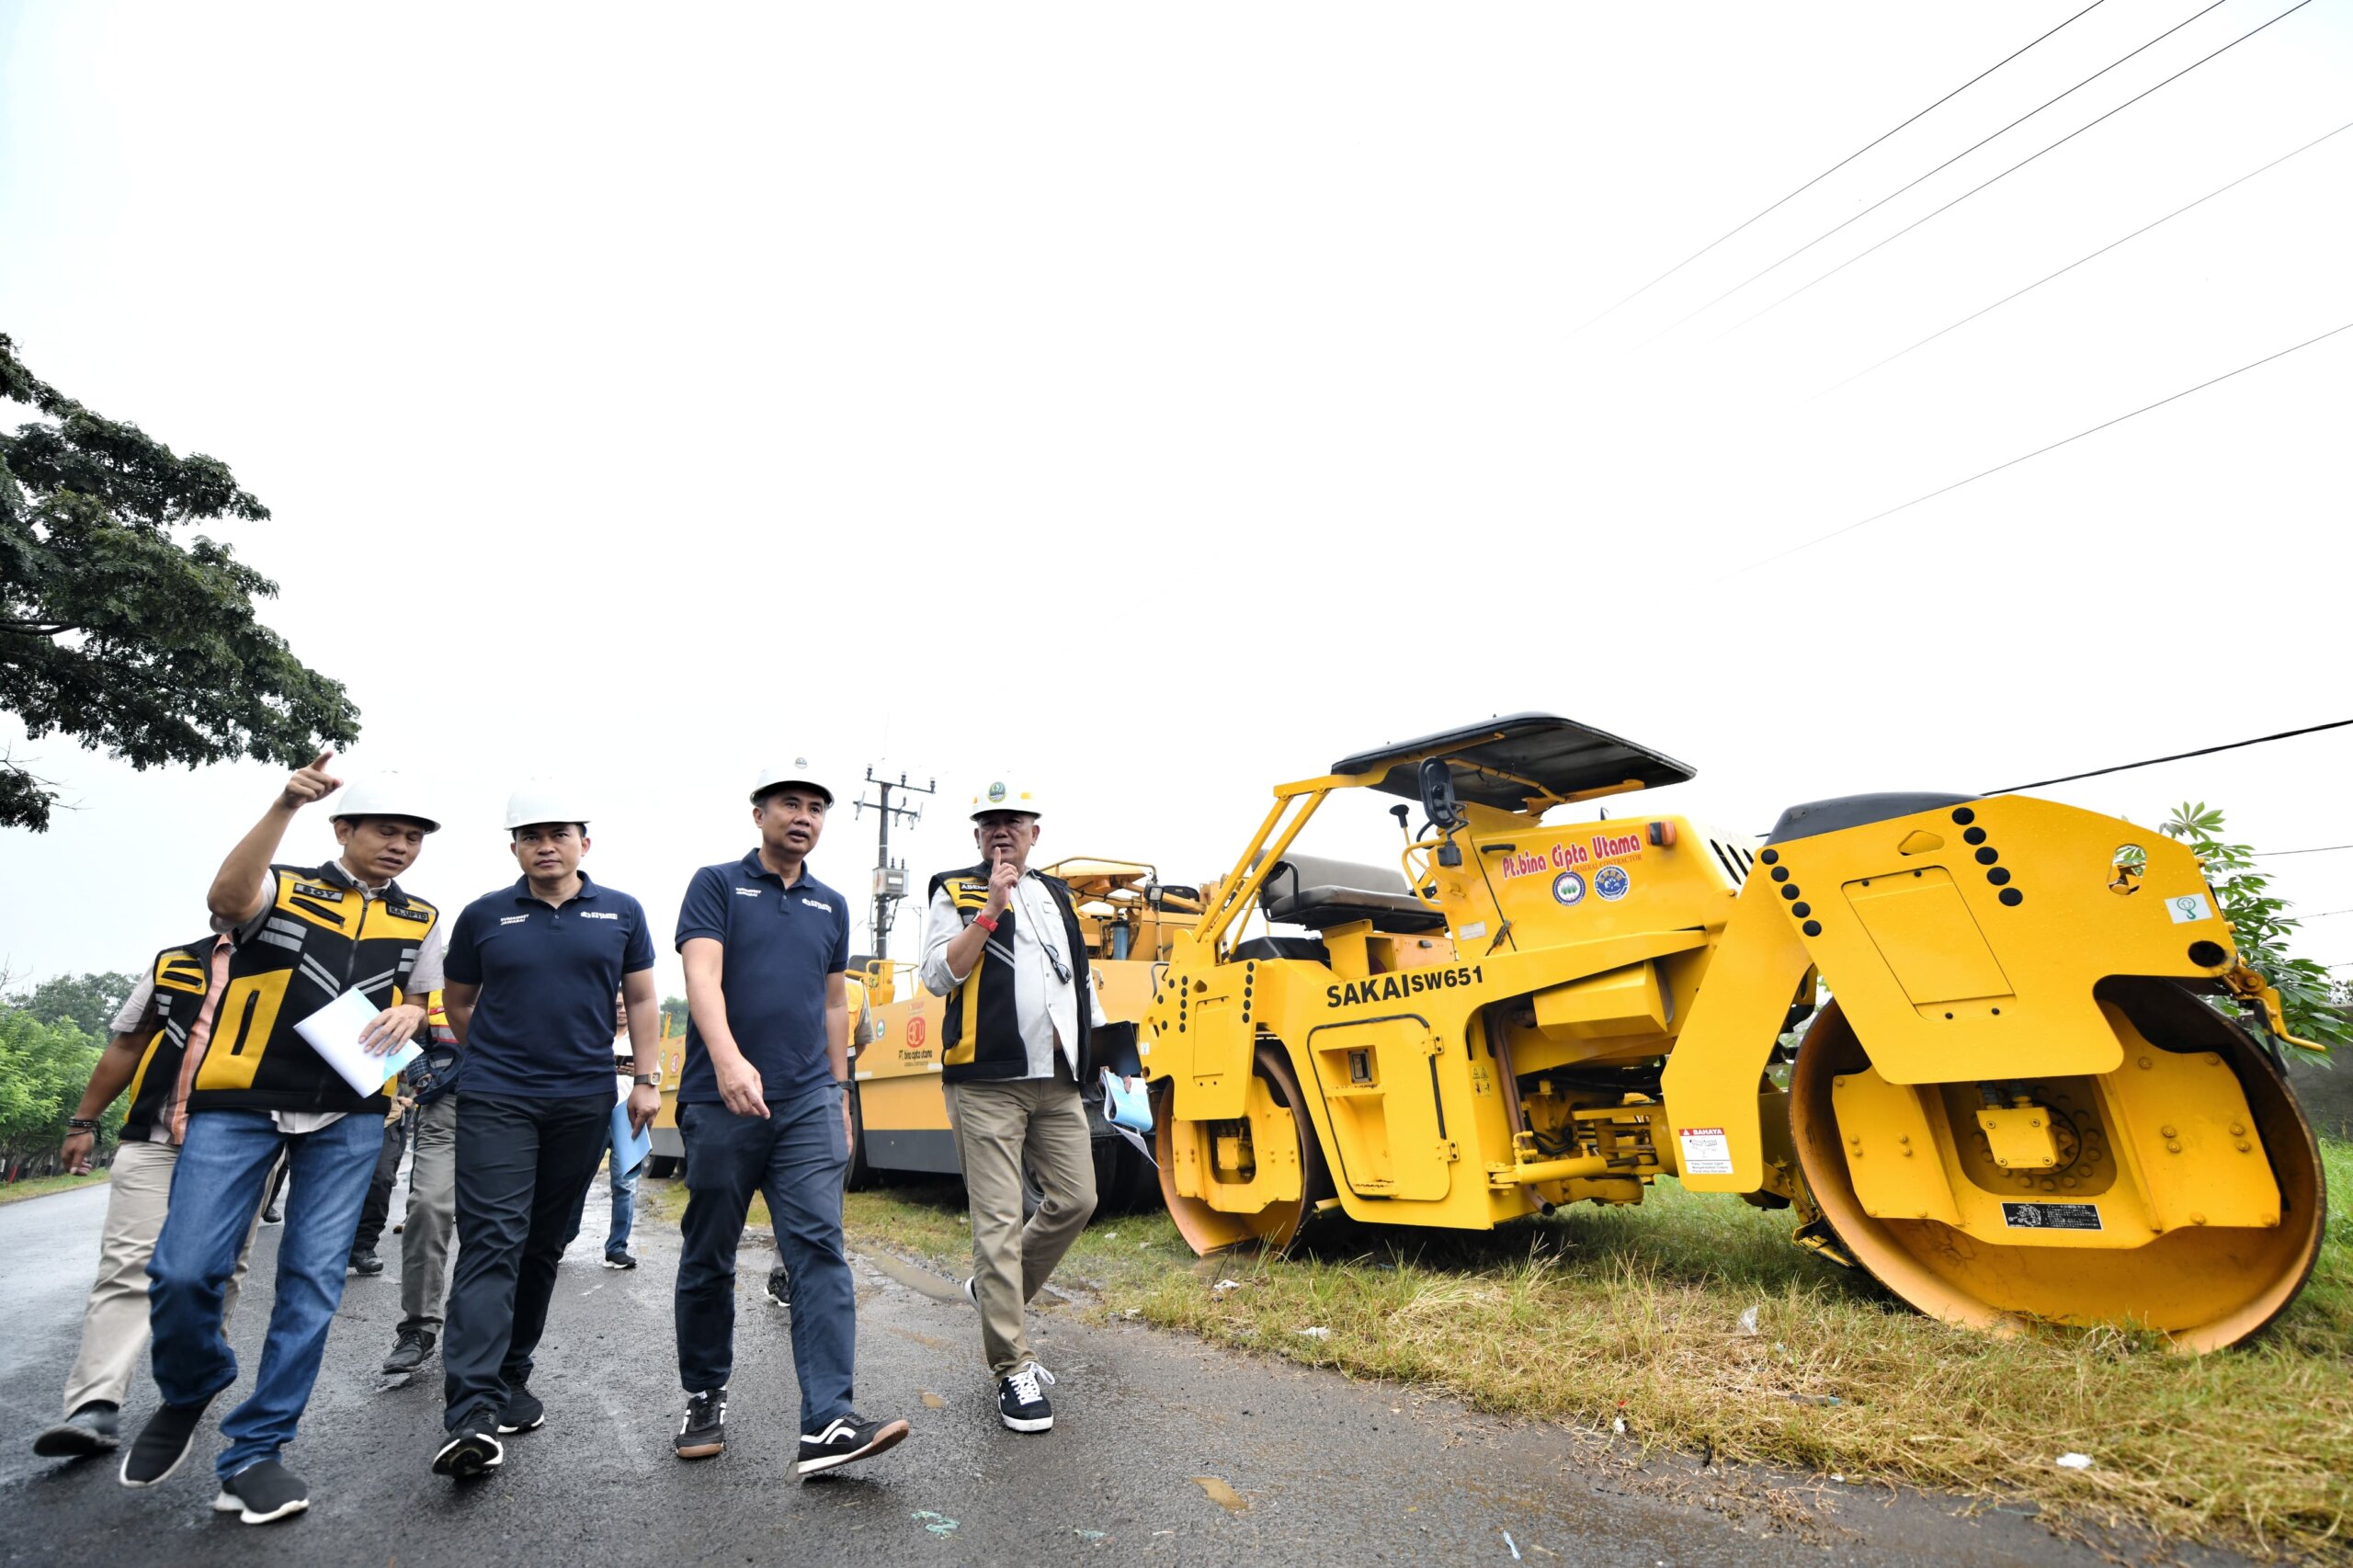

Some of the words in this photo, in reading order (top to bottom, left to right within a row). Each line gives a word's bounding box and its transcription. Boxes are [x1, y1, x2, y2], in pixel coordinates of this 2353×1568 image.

[1552, 843, 1587, 871] Cipta
[1592, 834, 1641, 859] Utama
[302, 885, 335, 898] BOY
[1326, 974, 1410, 1008] SAKAI
[1411, 965, 1483, 993] SW651
